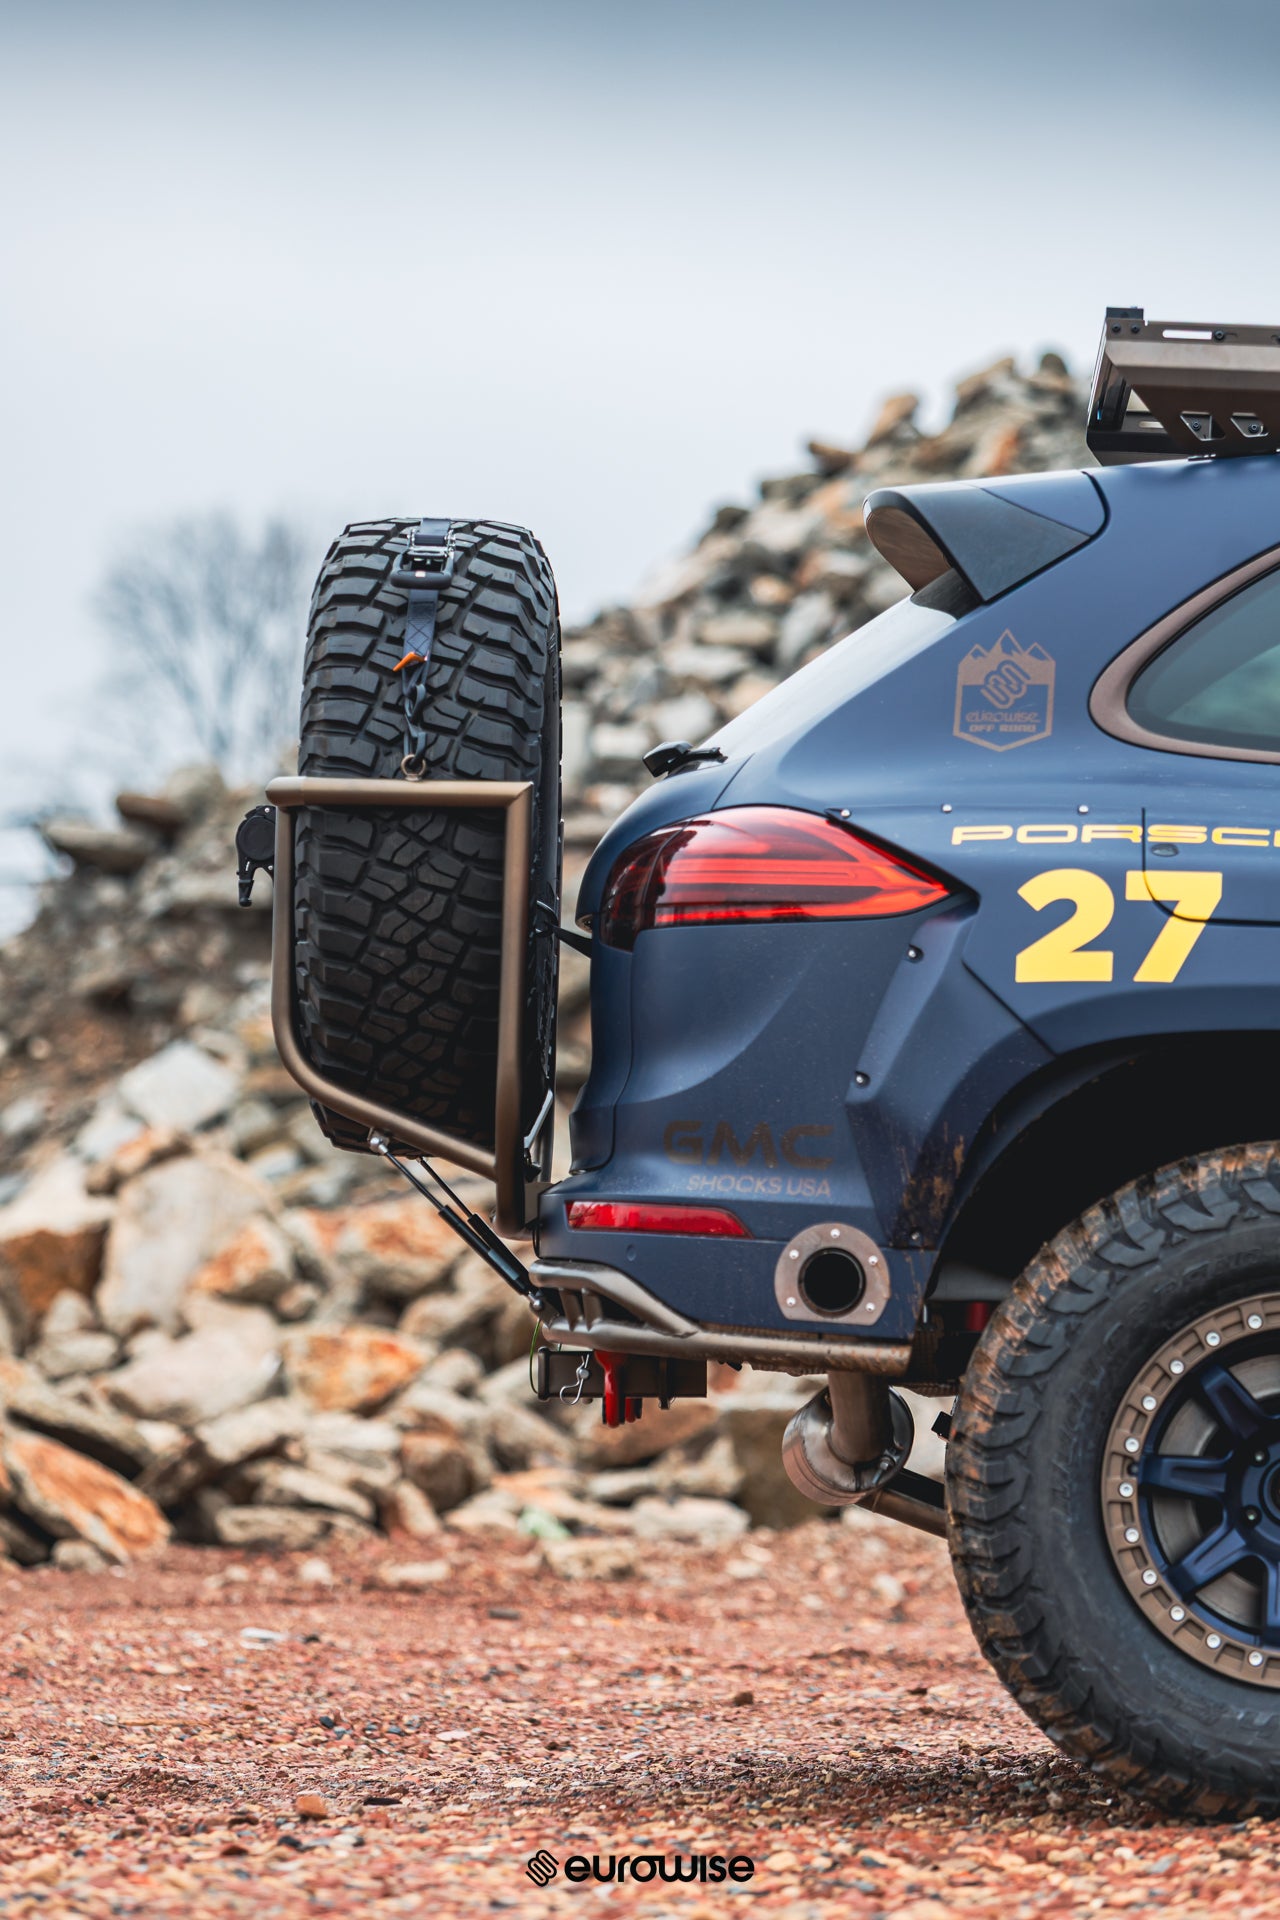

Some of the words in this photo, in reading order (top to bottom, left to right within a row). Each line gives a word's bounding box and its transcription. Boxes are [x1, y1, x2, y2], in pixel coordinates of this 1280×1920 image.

[969, 724, 995, 733] OFF
[951, 824, 1280, 848] PORSC
[1015, 868, 1223, 983] 27
[664, 1120, 835, 1171] GMC
[686, 1173, 783, 1195] SHOCKS
[786, 1175, 832, 1198] USA
